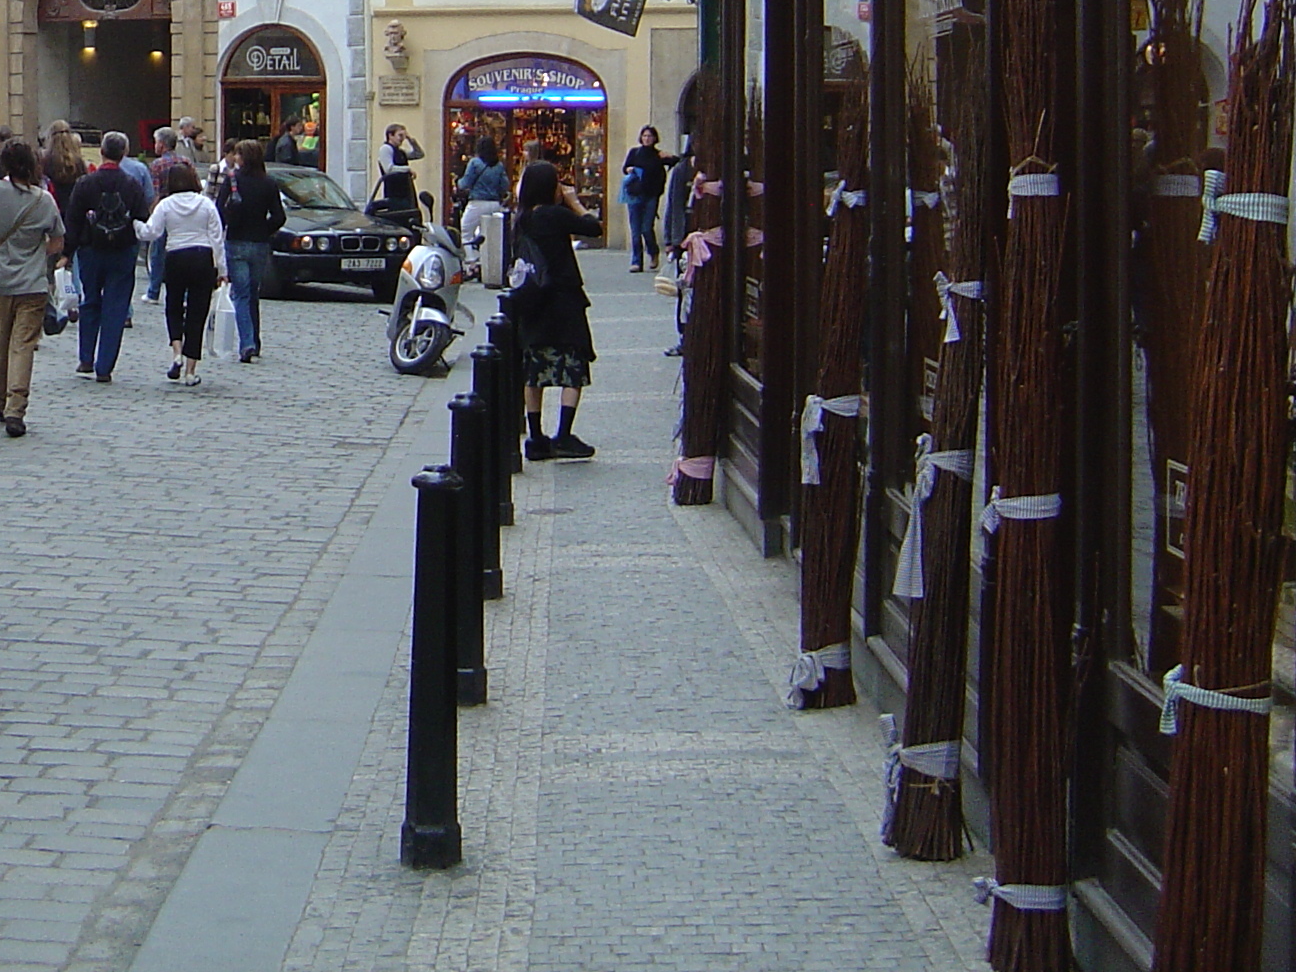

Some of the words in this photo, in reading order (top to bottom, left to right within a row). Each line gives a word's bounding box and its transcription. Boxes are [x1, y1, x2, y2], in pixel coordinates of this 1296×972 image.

[246, 46, 301, 71] DETAIL
[468, 68, 544, 91] SOUVENIR'S
[548, 69, 585, 89] SHOP
